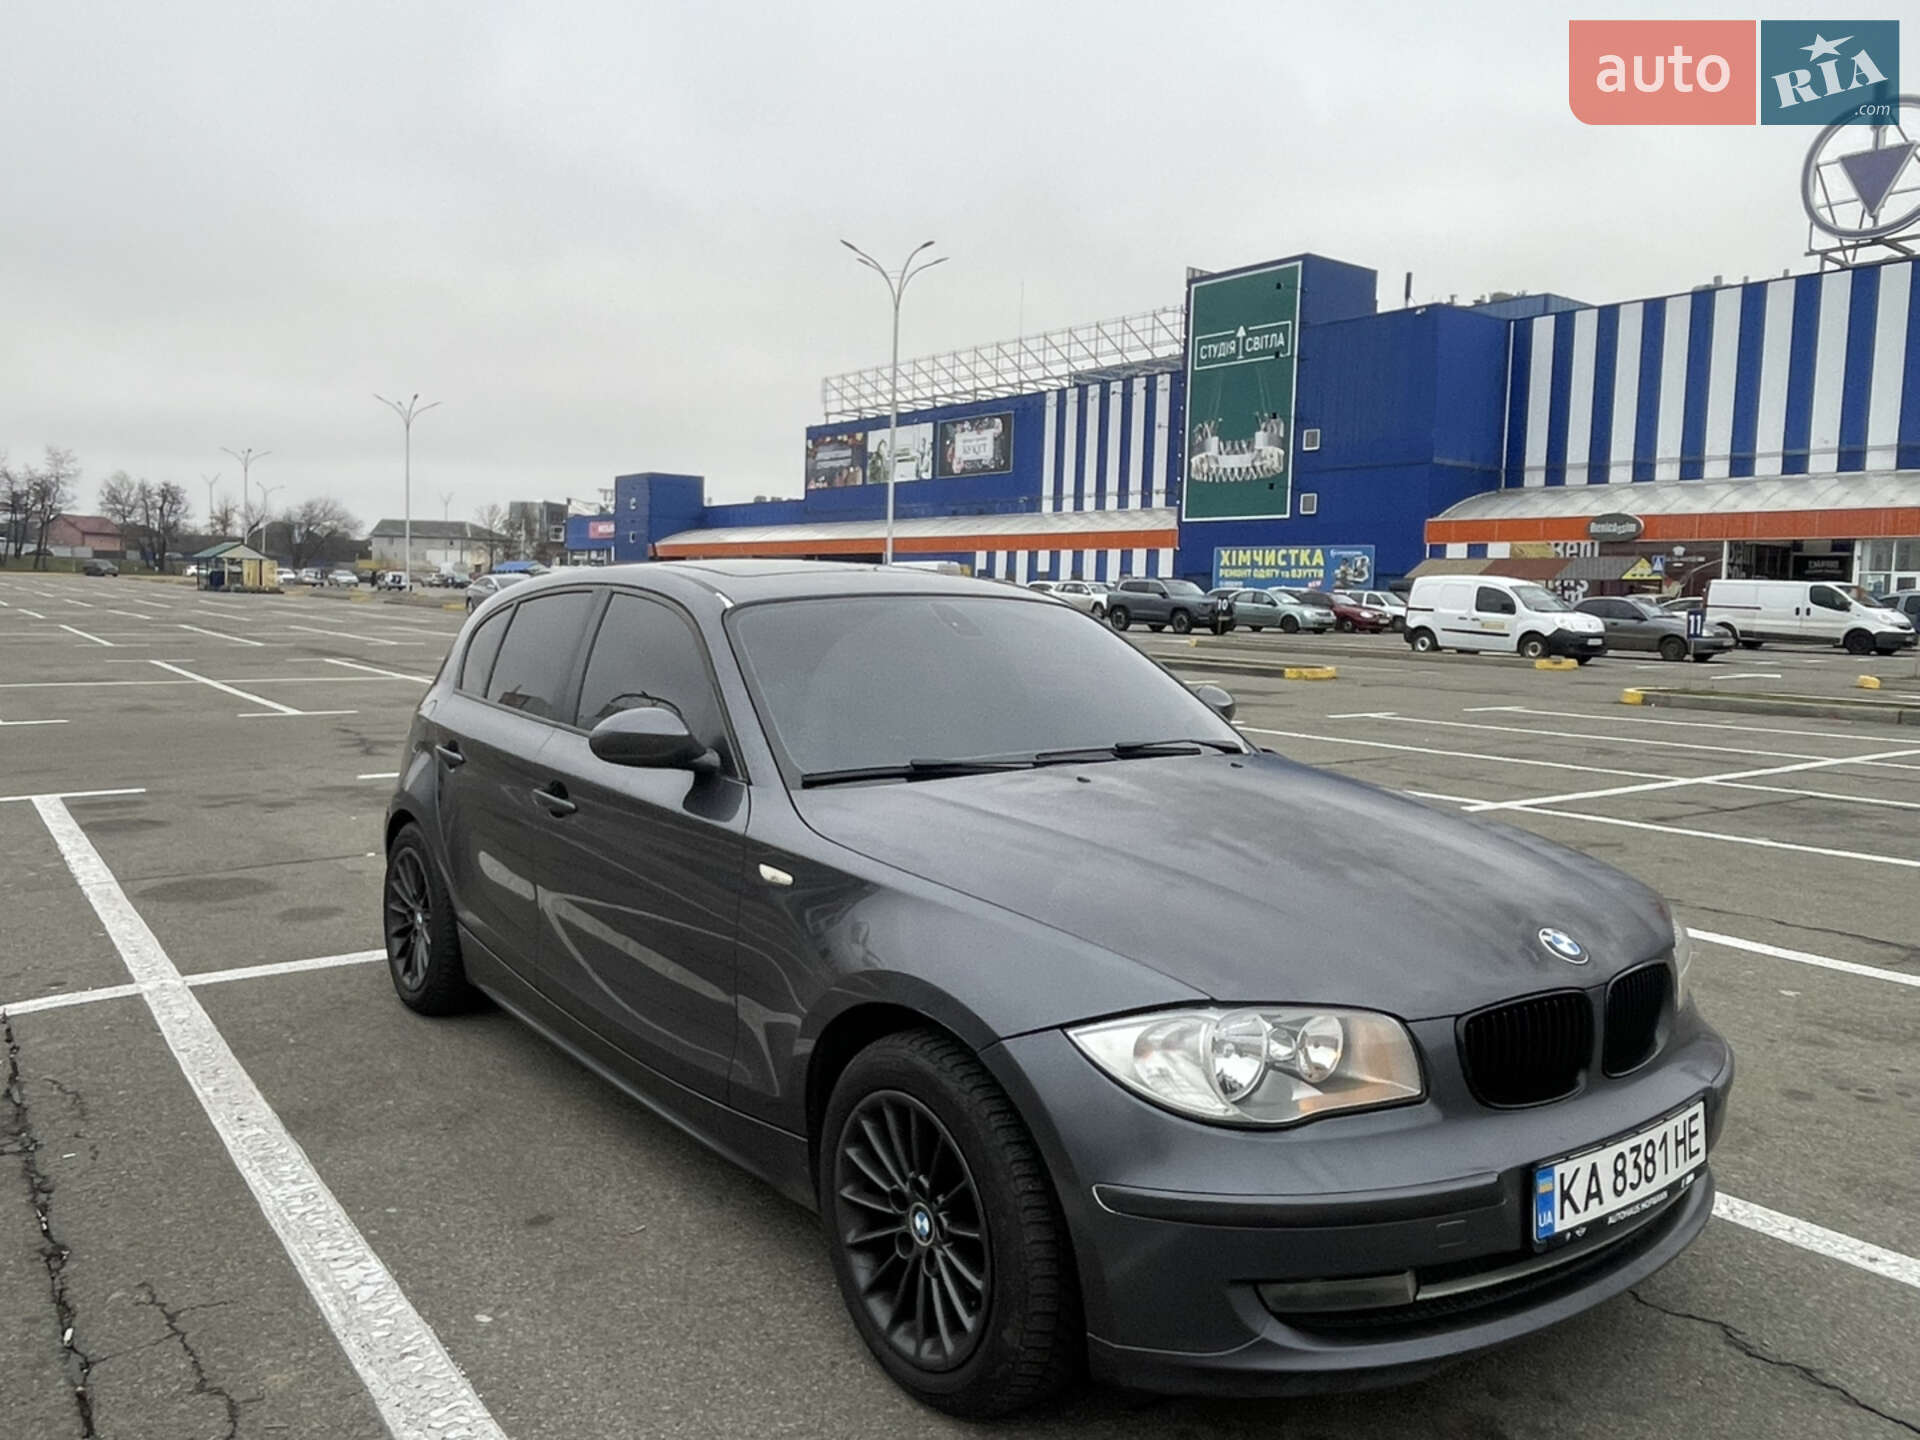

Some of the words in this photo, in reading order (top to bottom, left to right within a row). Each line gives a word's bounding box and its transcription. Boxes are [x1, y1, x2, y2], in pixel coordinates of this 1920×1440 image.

[1200, 340, 1236, 360] СТУДІЯ
[1244, 332, 1286, 353] СВІТЛА
[1219, 548, 1325, 566] ХІМЧИСТКА
[1219, 568, 1252, 579] РЕМОНТ
[1217, 598, 1229, 611] 10
[1689, 614, 1702, 635] 11
[1560, 1162, 1604, 1220] KA
[1613, 1131, 1669, 1197] 8381
[1674, 1112, 1700, 1169] HE
[1538, 1211, 1553, 1227] UA
